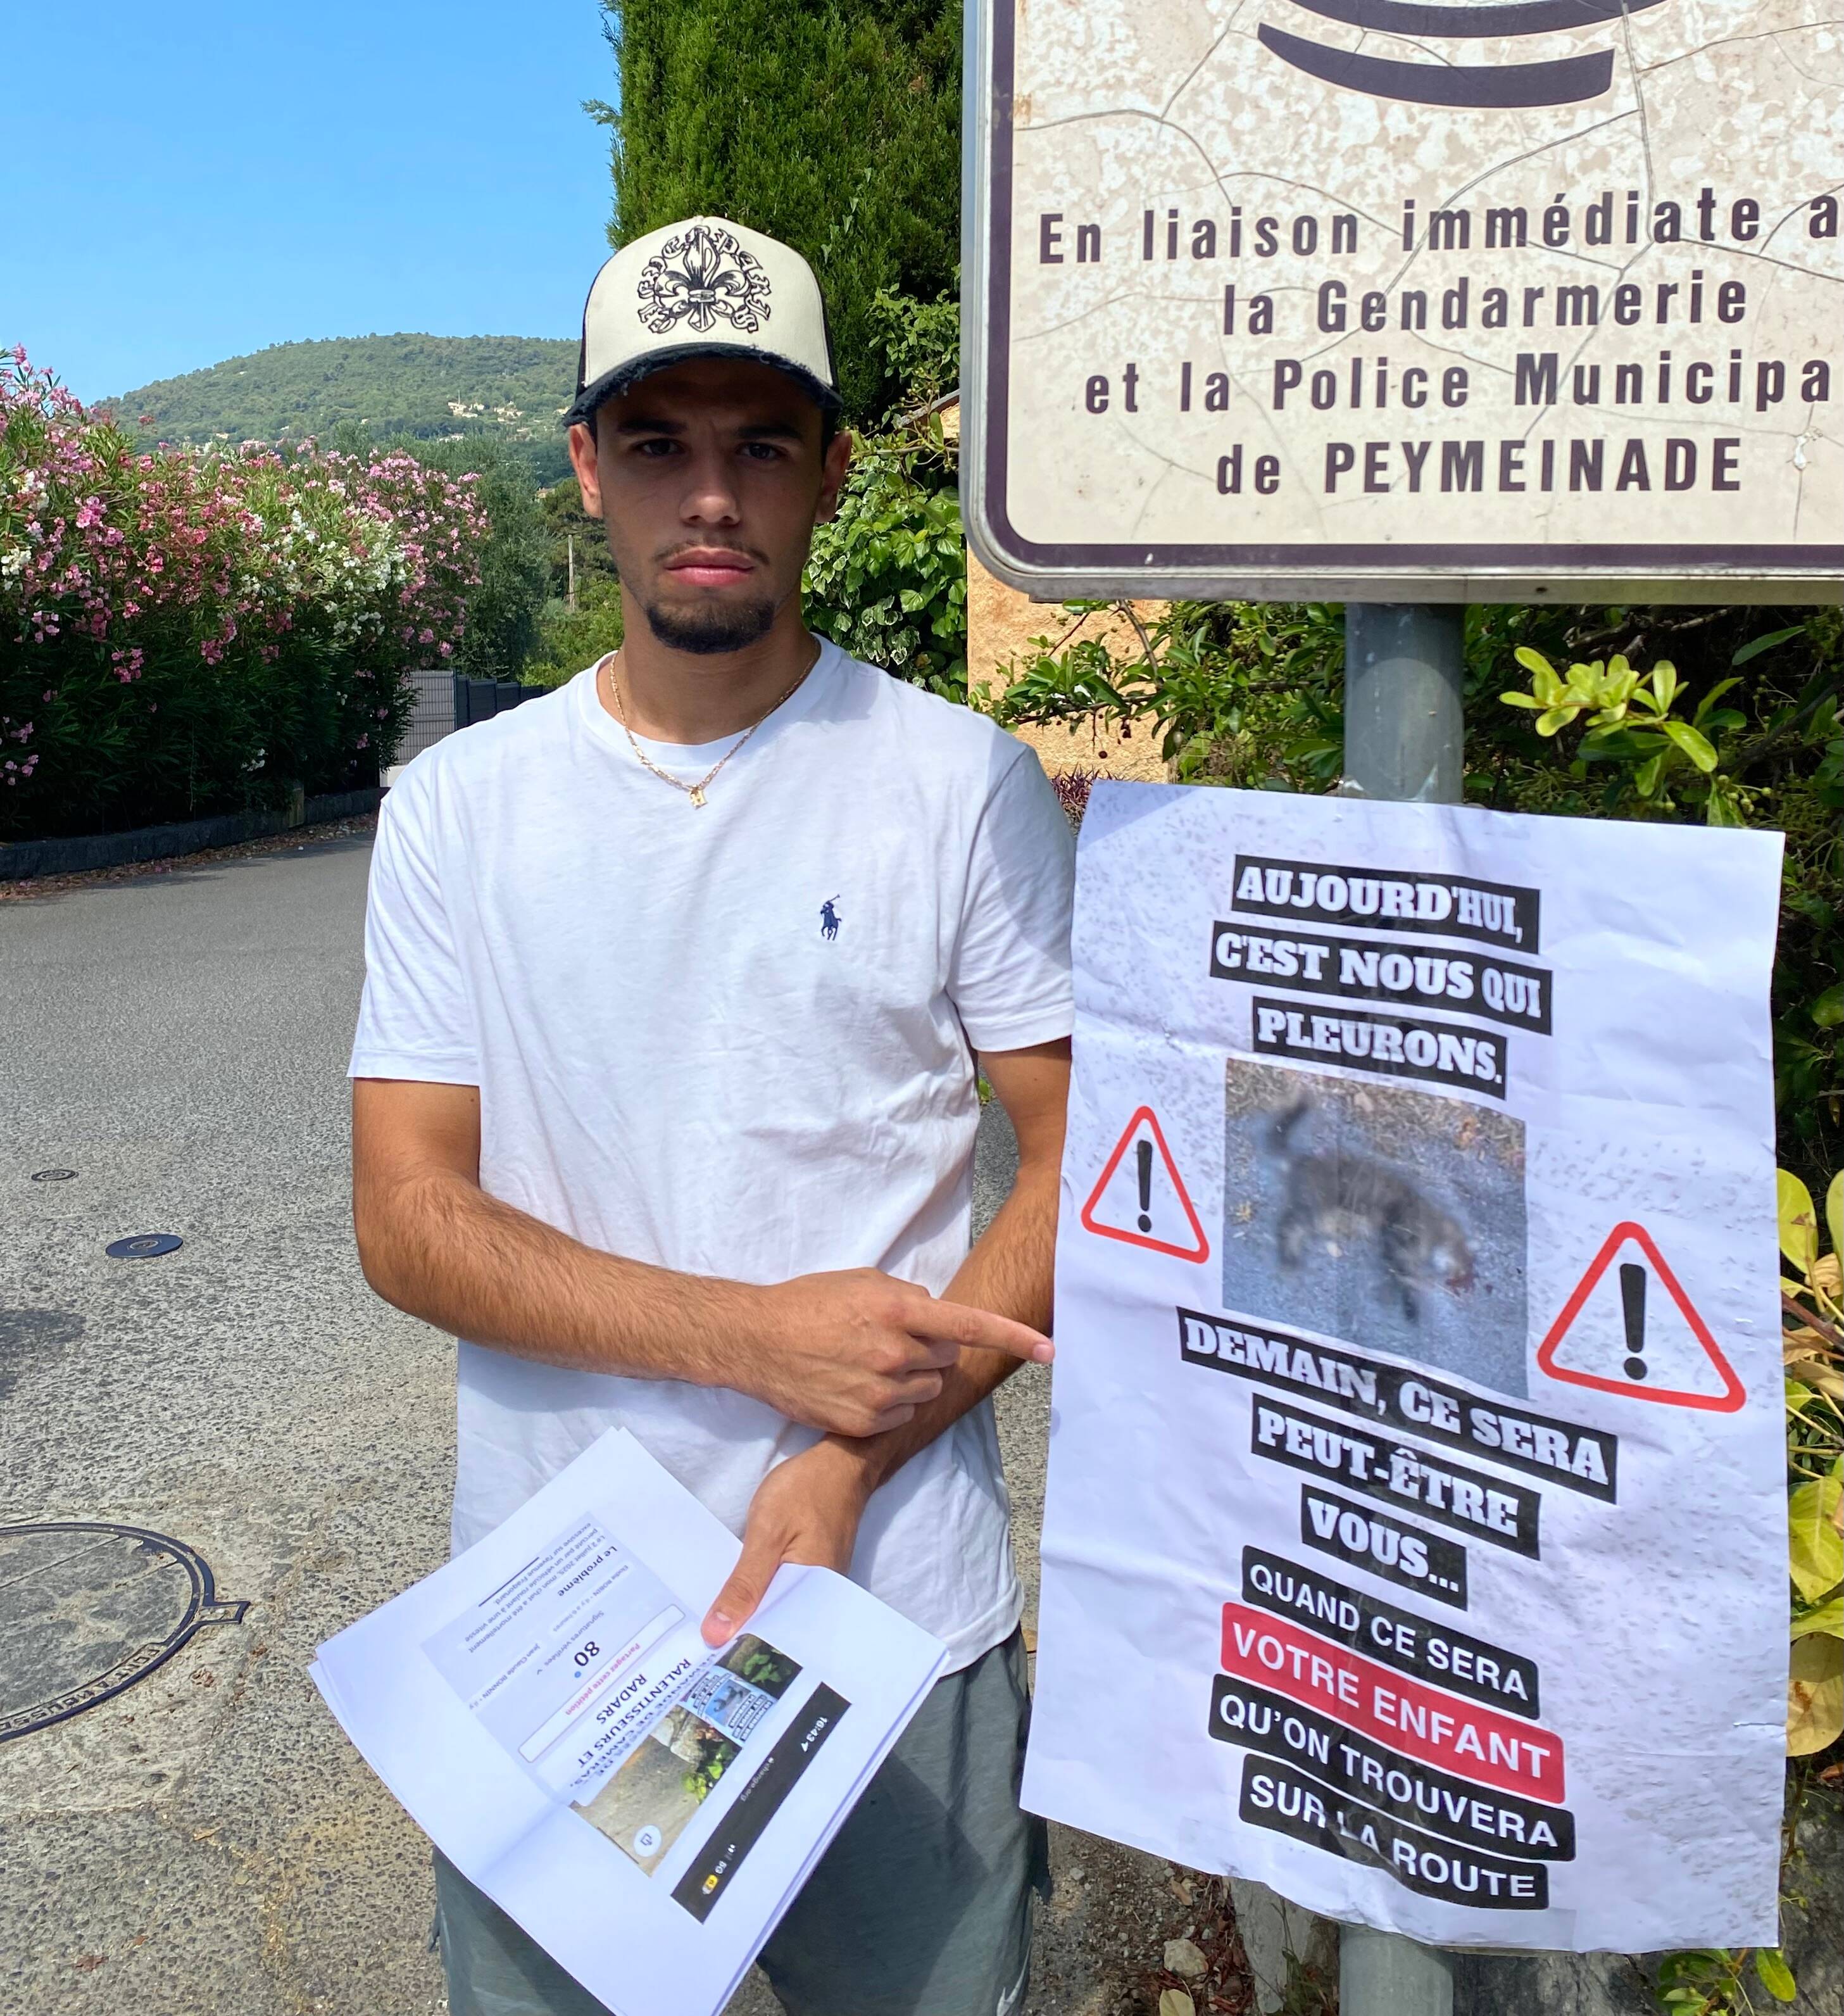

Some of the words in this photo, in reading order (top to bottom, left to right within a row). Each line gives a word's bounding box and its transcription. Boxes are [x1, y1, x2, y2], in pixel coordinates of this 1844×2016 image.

[1041, 214, 1100, 263] En
[1145, 207, 1356, 260] liaison
[1404, 188, 1759, 251] immédiate
[1225, 285, 1272, 334] la
[1319, 270, 1745, 332] Gendarmerie
[1086, 364, 1138, 413] et
[1182, 363, 1228, 412] la
[1274, 358, 1467, 409] Police
[1218, 444, 1279, 494] de
[1326, 438, 1739, 493] PEYMEINADE
[1236, 866, 1522, 943] AUJOURD'HUI,
[1215, 934, 1329, 980] C'EST
[1339, 948, 1473, 999] NOUS
[1481, 971, 1542, 1017] QUI
[1258, 1007, 1502, 1084] PLEURONS.
[1184, 1316, 1387, 1416] DEMAIN,
[1399, 1380, 1460, 1432] CE
[1472, 1412, 1609, 1485] SERA
[1257, 1406, 1518, 1537] PEUT-ÊTRE
[555, 1554, 604, 1597] problème
[603, 1545, 617, 1558] Le
[1307, 1495, 1460, 1592] VOUS...
[571, 1639, 601, 1668] 80
[1250, 1564, 1360, 1632] QUAND
[1371, 1615, 1416, 1658] CE
[1427, 1638, 1529, 1701] SERA
[593, 1658, 691, 1752] RALENTISSEURS
[594, 1673, 647, 1725] RADARS
[1232, 1622, 1360, 1708] VOTRE
[1374, 1685, 1551, 1779] ENFANT
[575, 1749, 594, 1768] ET
[1219, 1694, 1329, 1765] QU'ON
[1341, 1744, 1558, 1848] TROUVERA
[1250, 1775, 1326, 1828] SUR
[1336, 1811, 1380, 1855] LA
[1393, 1838, 1536, 1898] ROUTE
